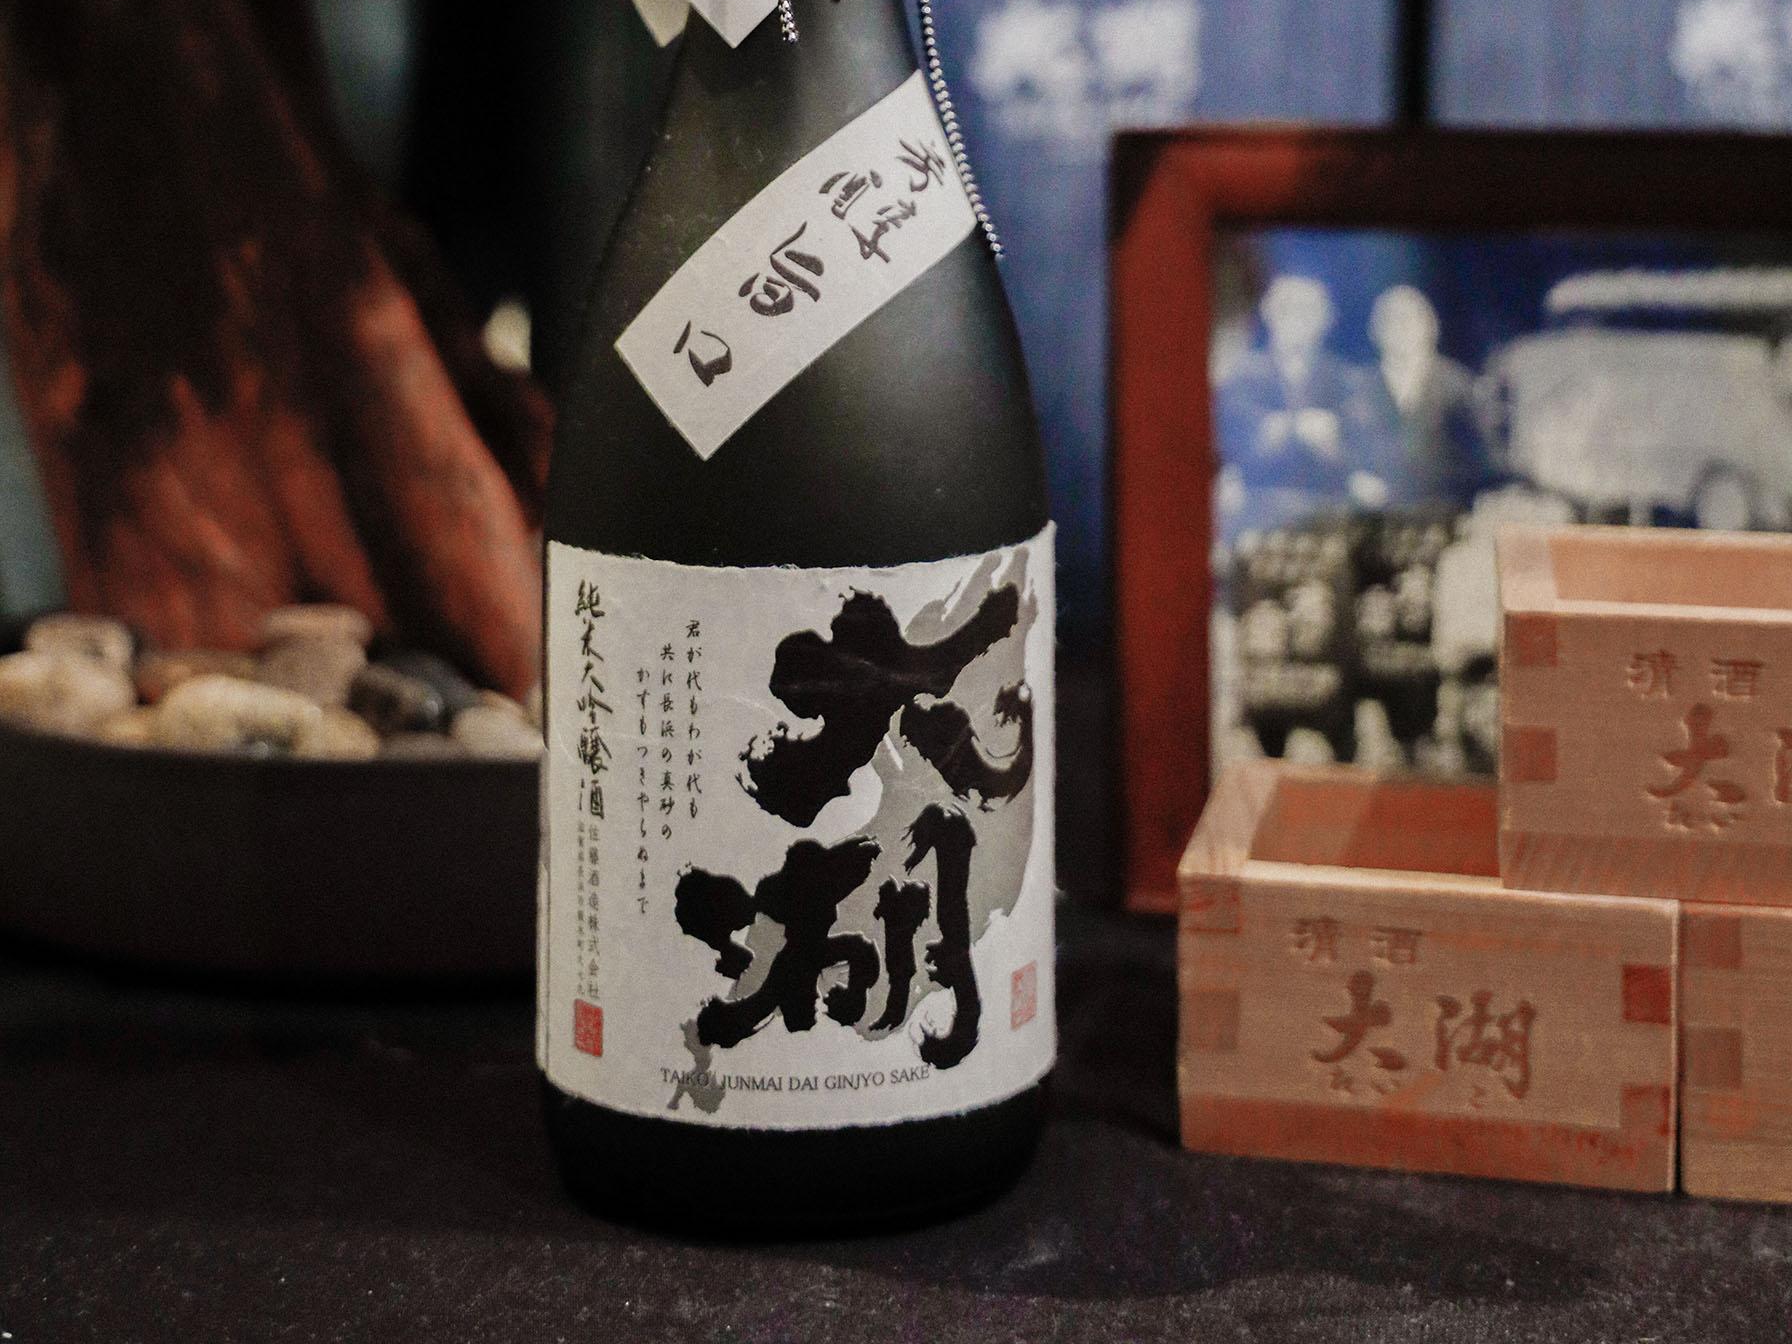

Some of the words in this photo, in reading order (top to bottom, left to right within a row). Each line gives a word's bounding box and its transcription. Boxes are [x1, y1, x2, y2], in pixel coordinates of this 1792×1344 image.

[660, 1067, 709, 1087] TAIKO
[720, 1073, 783, 1091] JUNMAI
[788, 1076, 819, 1092] DAI
[824, 1070, 885, 1090] GINJYO
[890, 1064, 931, 1084] SAKE
